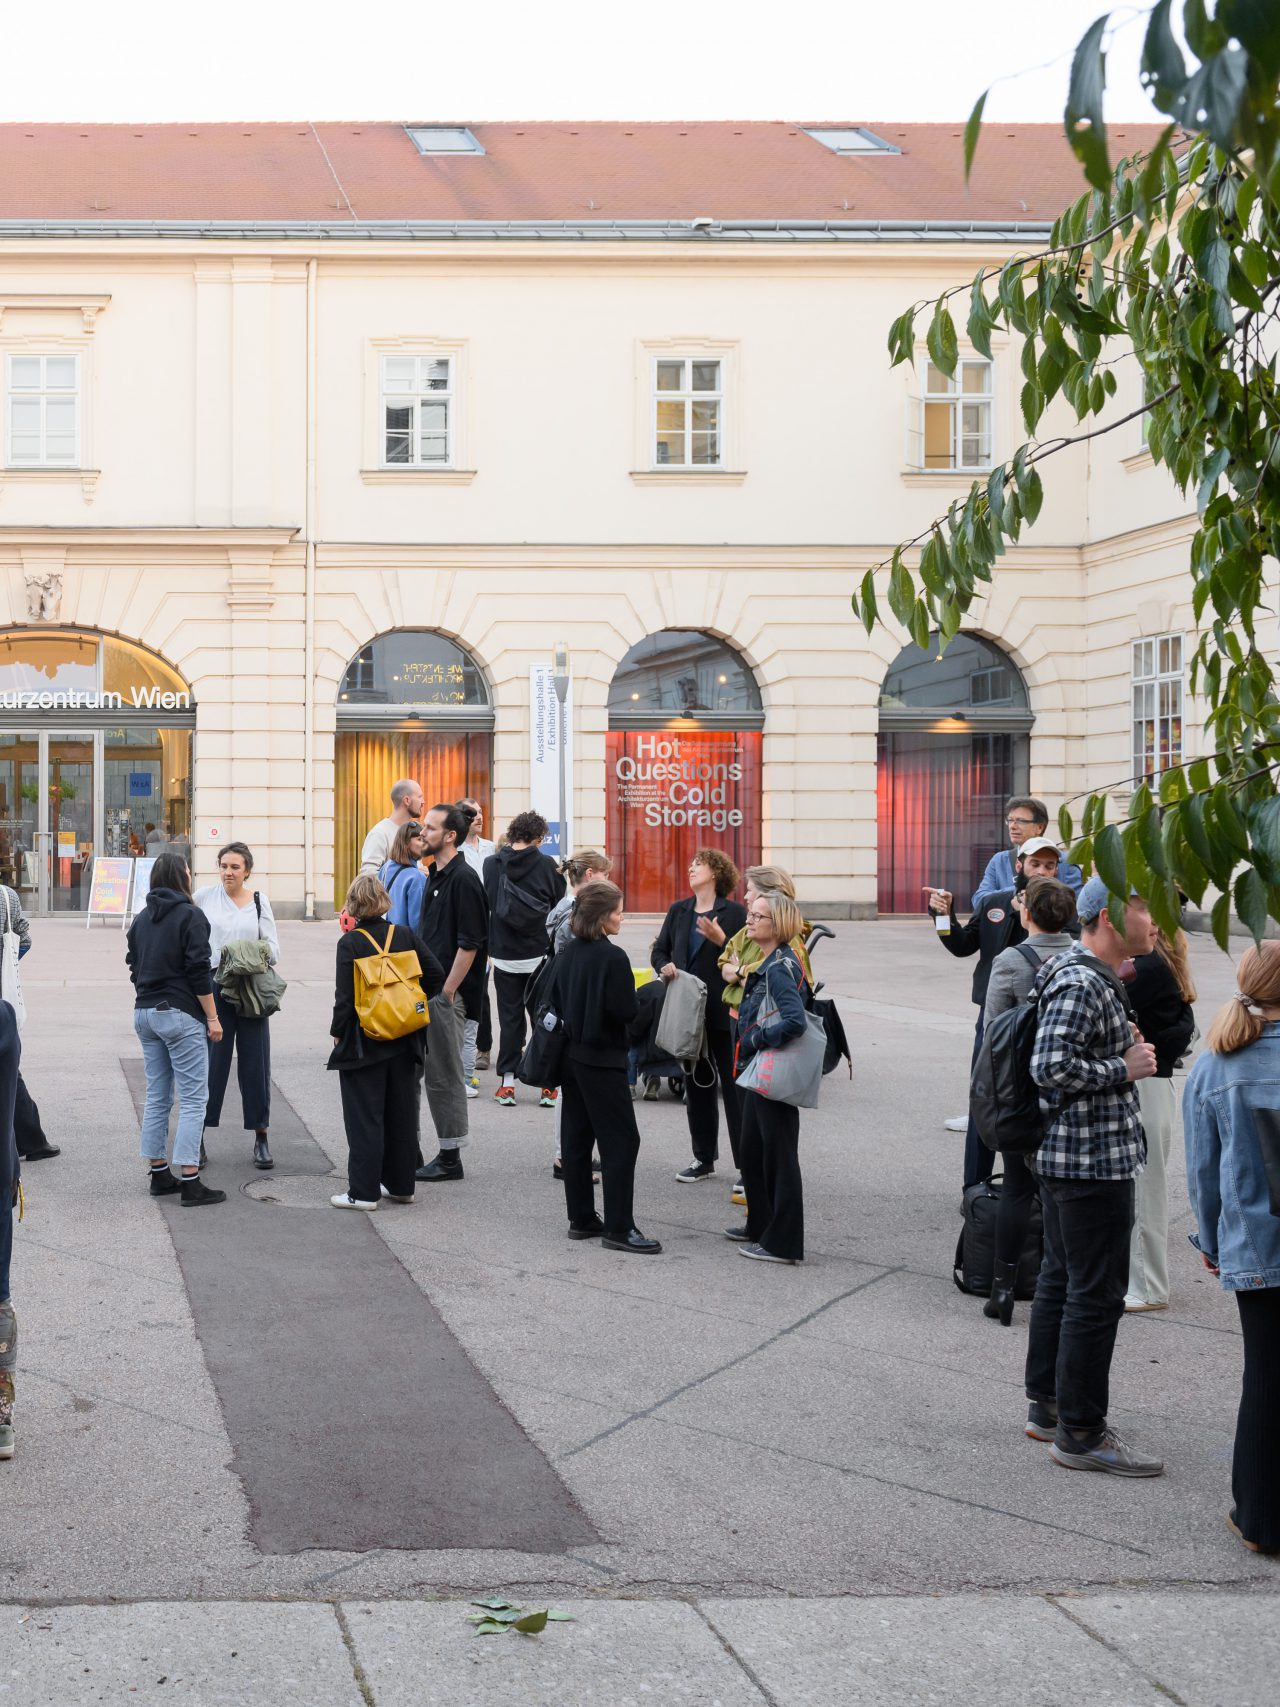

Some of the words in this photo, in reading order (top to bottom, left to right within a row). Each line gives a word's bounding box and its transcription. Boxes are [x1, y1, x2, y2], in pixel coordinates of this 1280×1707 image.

[130, 686, 190, 709] Wien
[536, 675, 545, 763] Ausstellungshalle
[548, 696, 556, 746] Exhibition
[637, 735, 681, 759] Hot
[616, 757, 742, 781] Questions
[669, 781, 726, 805] Cold
[645, 803, 743, 832] Storage
